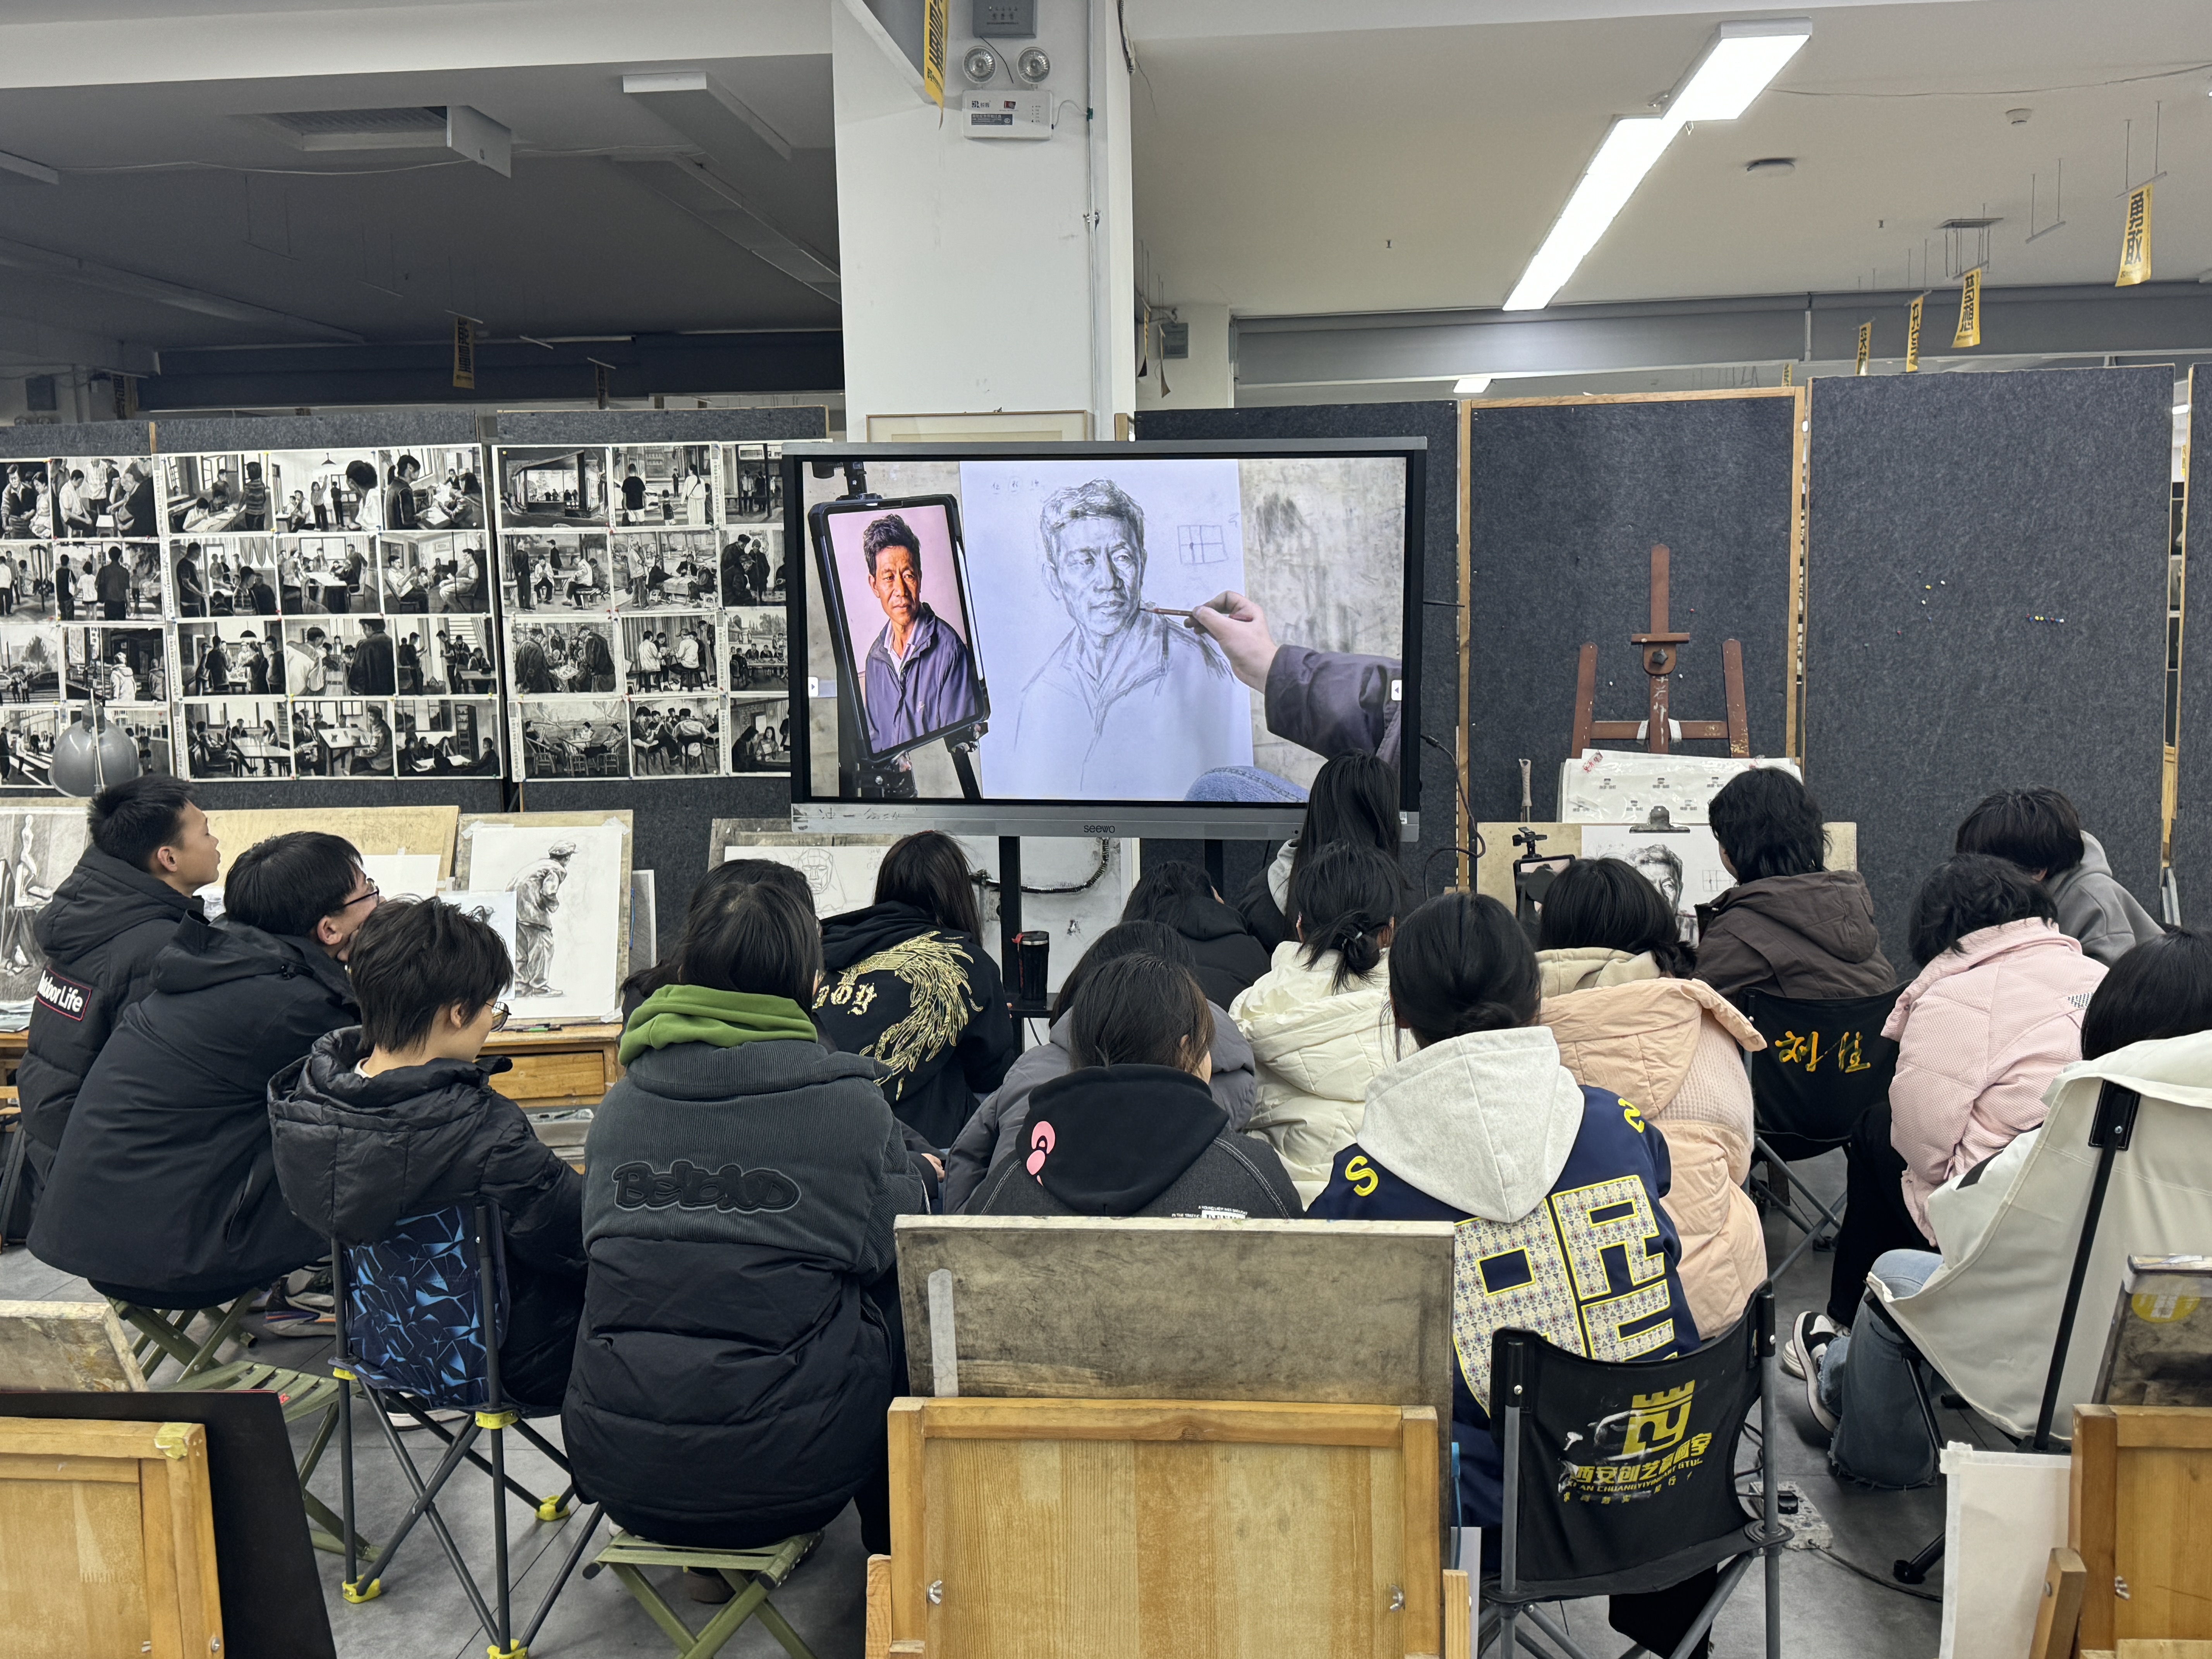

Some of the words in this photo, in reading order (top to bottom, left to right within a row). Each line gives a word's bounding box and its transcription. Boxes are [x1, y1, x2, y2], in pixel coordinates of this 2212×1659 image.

[2124, 191, 2144, 265] 勇敢
[1084, 825, 1115, 833] seewo
[58, 986, 83, 1012] Life
